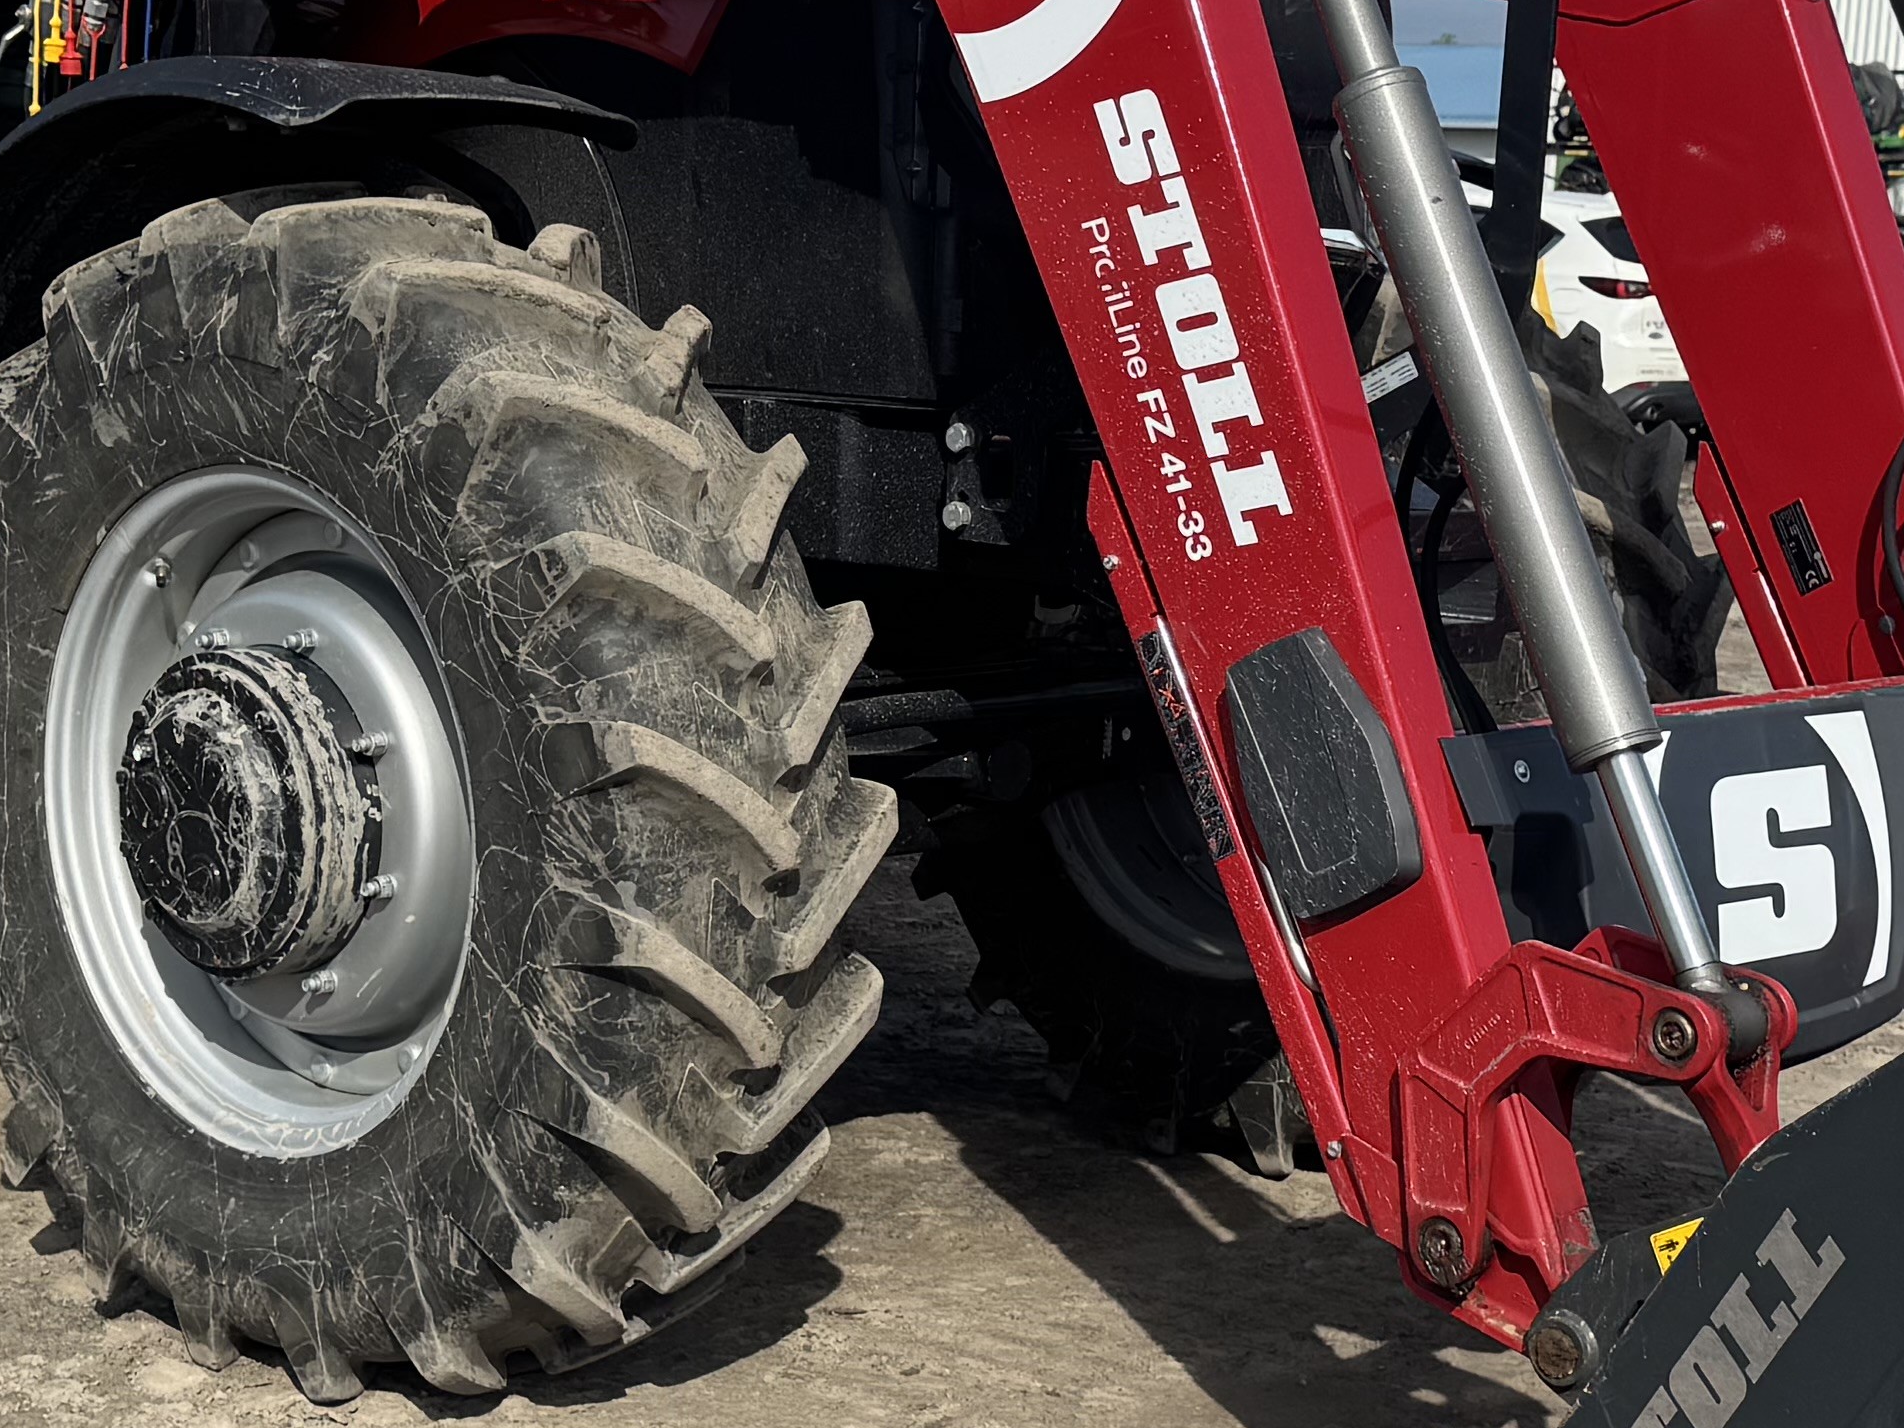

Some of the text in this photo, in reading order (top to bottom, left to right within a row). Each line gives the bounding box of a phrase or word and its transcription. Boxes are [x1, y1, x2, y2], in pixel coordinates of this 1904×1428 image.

[1094, 89, 1293, 547] STOLL
[1136, 389, 1176, 444] FZ
[1160, 453, 1213, 562] 41-33
[1710, 764, 1838, 966] S
